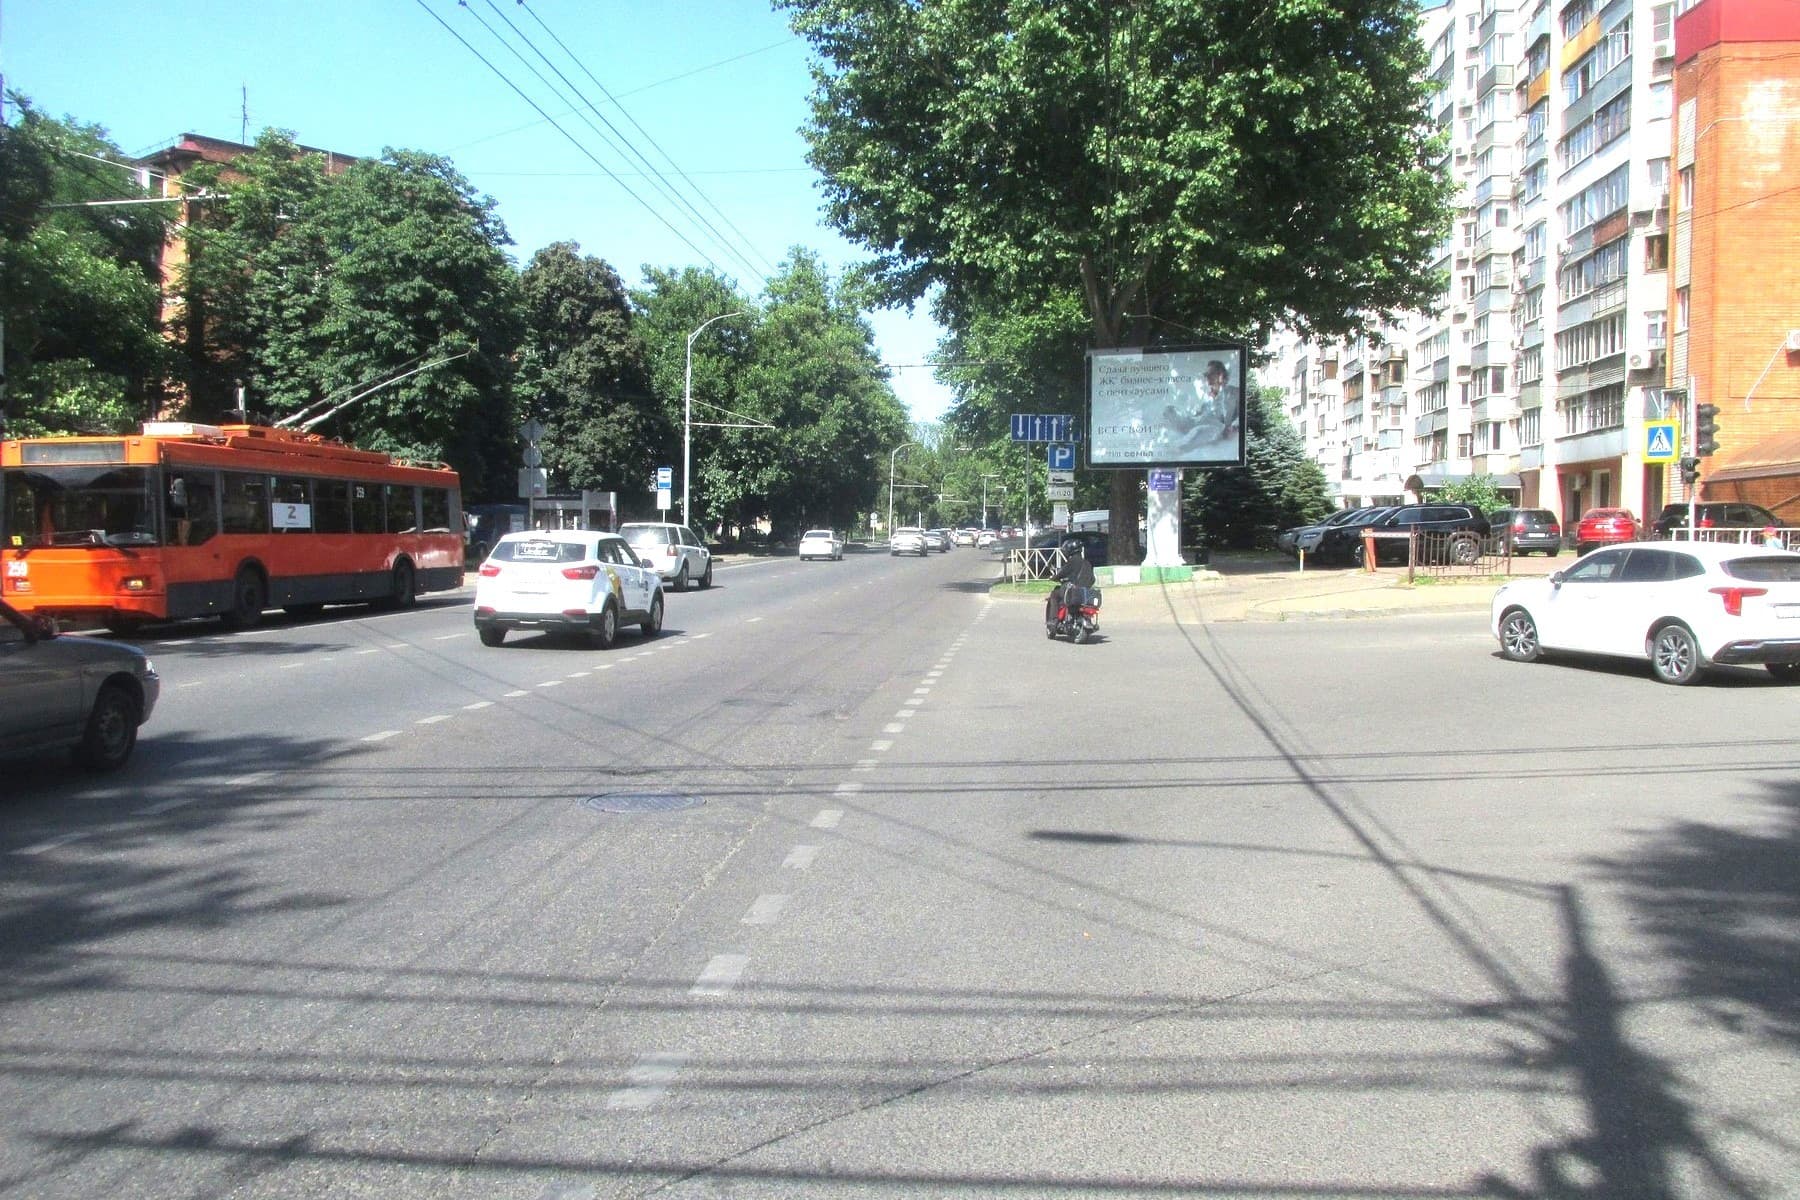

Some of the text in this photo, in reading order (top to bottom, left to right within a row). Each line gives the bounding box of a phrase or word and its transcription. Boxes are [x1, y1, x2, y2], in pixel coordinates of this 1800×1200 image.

[1130, 364, 1170, 375] лучшего
[1098, 425, 1117, 434] ВСЕ
[1055, 447, 1071, 467] P
